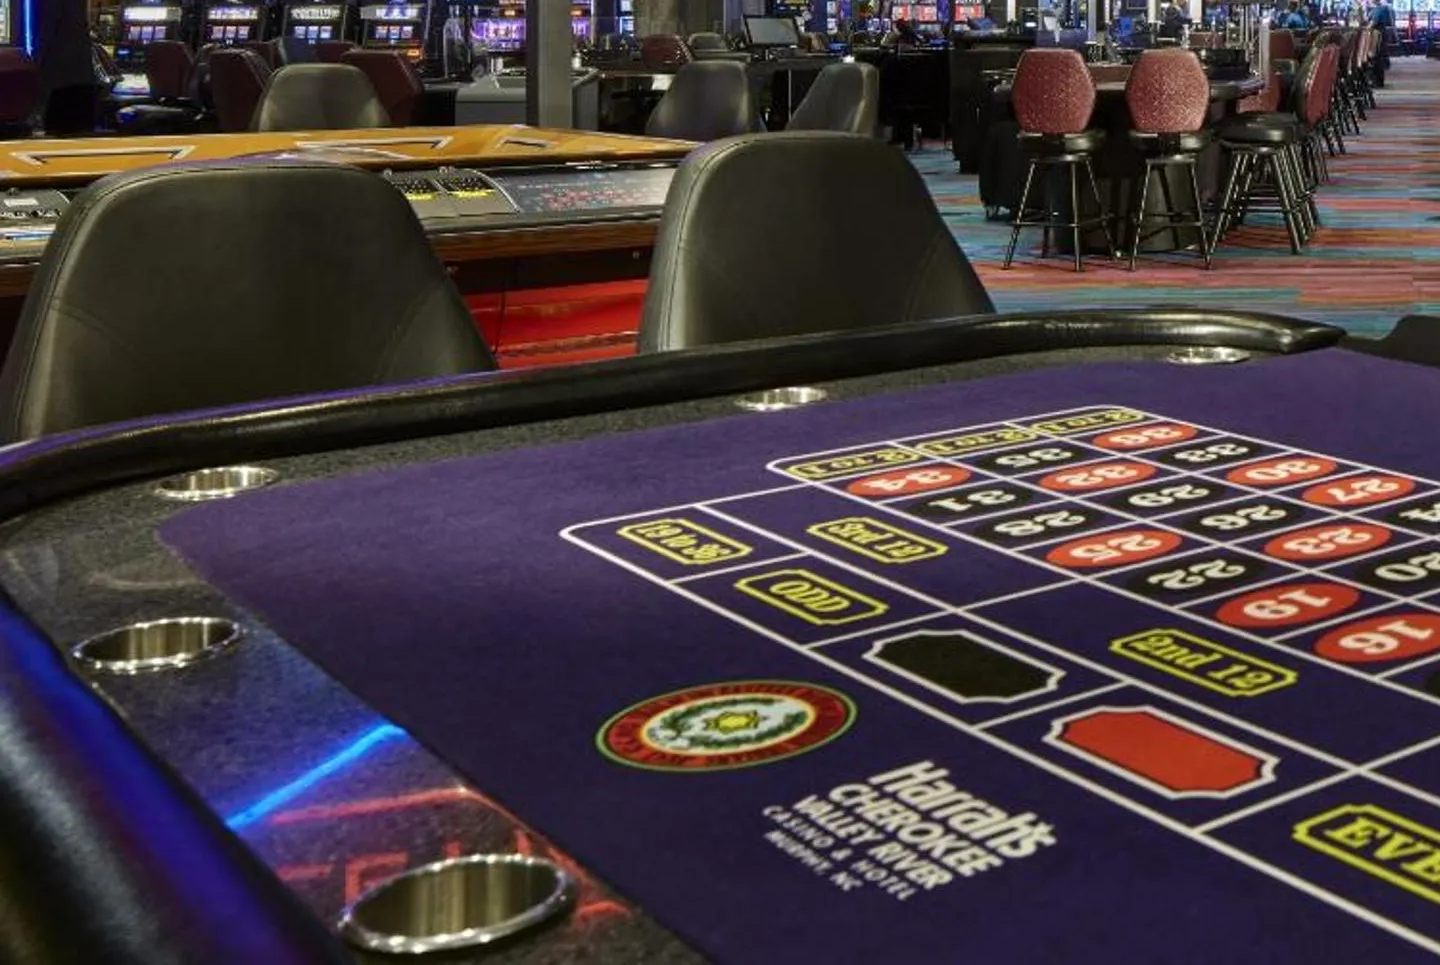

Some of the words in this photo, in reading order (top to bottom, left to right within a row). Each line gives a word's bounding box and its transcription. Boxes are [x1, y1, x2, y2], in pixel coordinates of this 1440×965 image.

[1108, 426, 1183, 447] 36
[995, 447, 1072, 468] 35
[1173, 443, 1249, 463] 33
[865, 467, 954, 494] 34
[1055, 464, 1139, 487] 32
[1245, 460, 1321, 481] 30
[932, 488, 1018, 514] 31
[1128, 484, 1210, 507] 29
[1327, 477, 1399, 504] 27
[994, 510, 1086, 536] 28
[1200, 505, 1287, 530] 26
[1069, 533, 1161, 563] 25
[1283, 526, 1372, 555] 23
[1147, 559, 1245, 589] 22
[769, 580, 850, 613] ODD
[1243, 590, 1330, 619] 19
[1339, 621, 1432, 654] 16
[1130, 635, 1223, 668] 2nd
[1207, 664, 1273, 689] 12
[792, 794, 886, 845] VALLEY
[867, 840, 954, 890] RIVER
[828, 783, 1003, 877] CHEROKEE
[762, 805, 834, 848] CASINO
[851, 859, 917, 901] HOTEL
